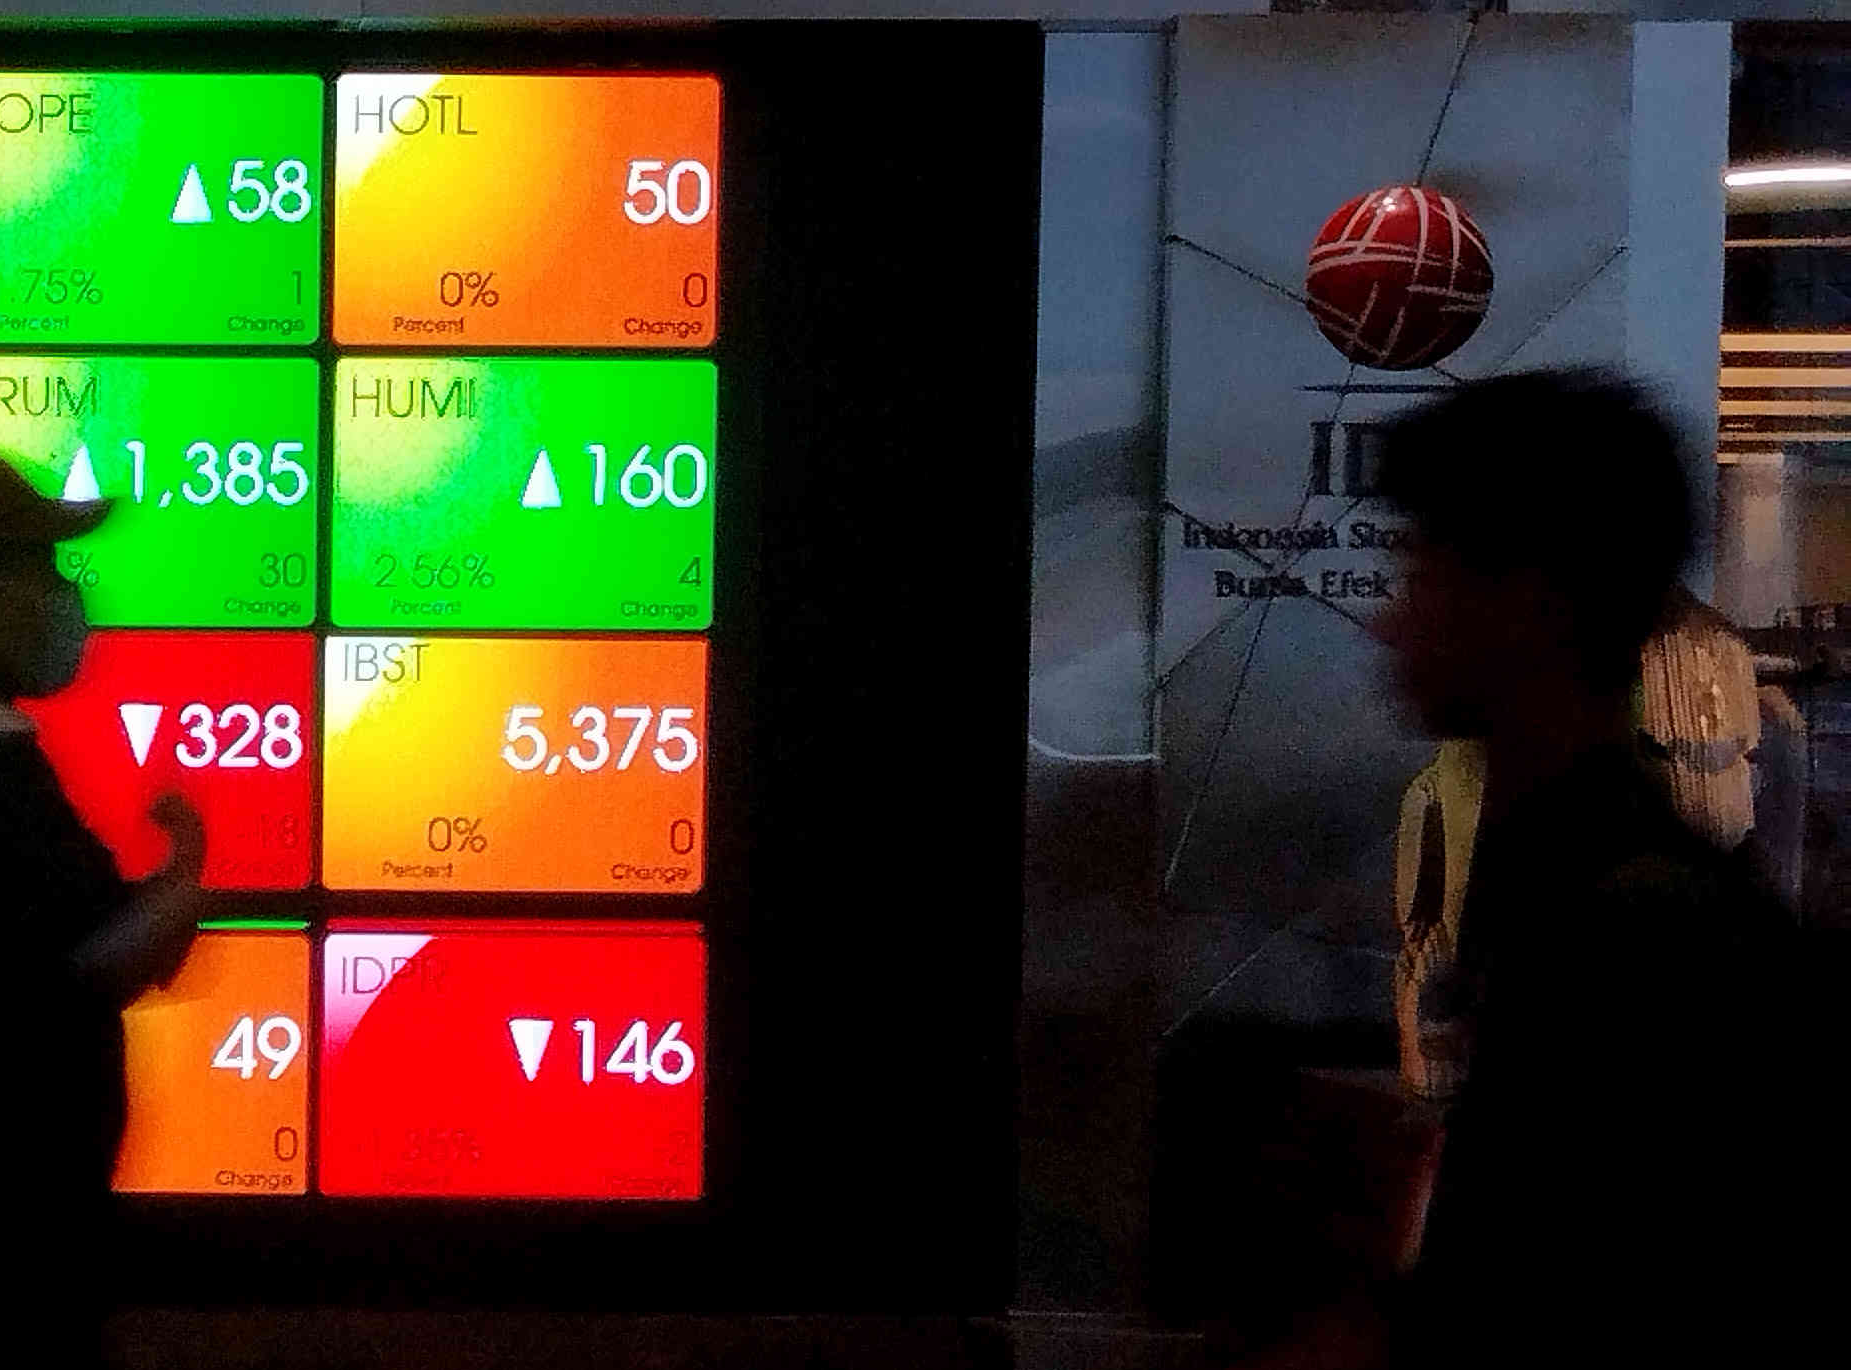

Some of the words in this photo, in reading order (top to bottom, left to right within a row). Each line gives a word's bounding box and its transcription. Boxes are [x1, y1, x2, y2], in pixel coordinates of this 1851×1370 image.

[354, 94, 478, 136] HOTL
[227, 158, 312, 223] 58
[622, 159, 712, 225] 50
[291, 270, 302, 305] 1
[440, 271, 499, 308] 0%
[683, 272, 707, 308] 0
[393, 316, 464, 334] Percent
[623, 318, 702, 339] Change
[351, 376, 478, 421] HUMI
[124, 440, 309, 508] 1,385
[586, 443, 708, 509] 160
[259, 552, 307, 589] 30
[679, 556, 701, 591] 4
[1318, 570, 1392, 600] Efek
[343, 642, 430, 683] IBST
[175, 703, 303, 769] 328
[501, 704, 698, 775] 5,375
[428, 816, 487, 854] 0%
[670, 818, 694, 855] 0
[210, 1015, 301, 1080] 49
[572, 1018, 695, 1086] 146
[275, 1126, 298, 1161] 0
[215, 1170, 294, 1189] Change
